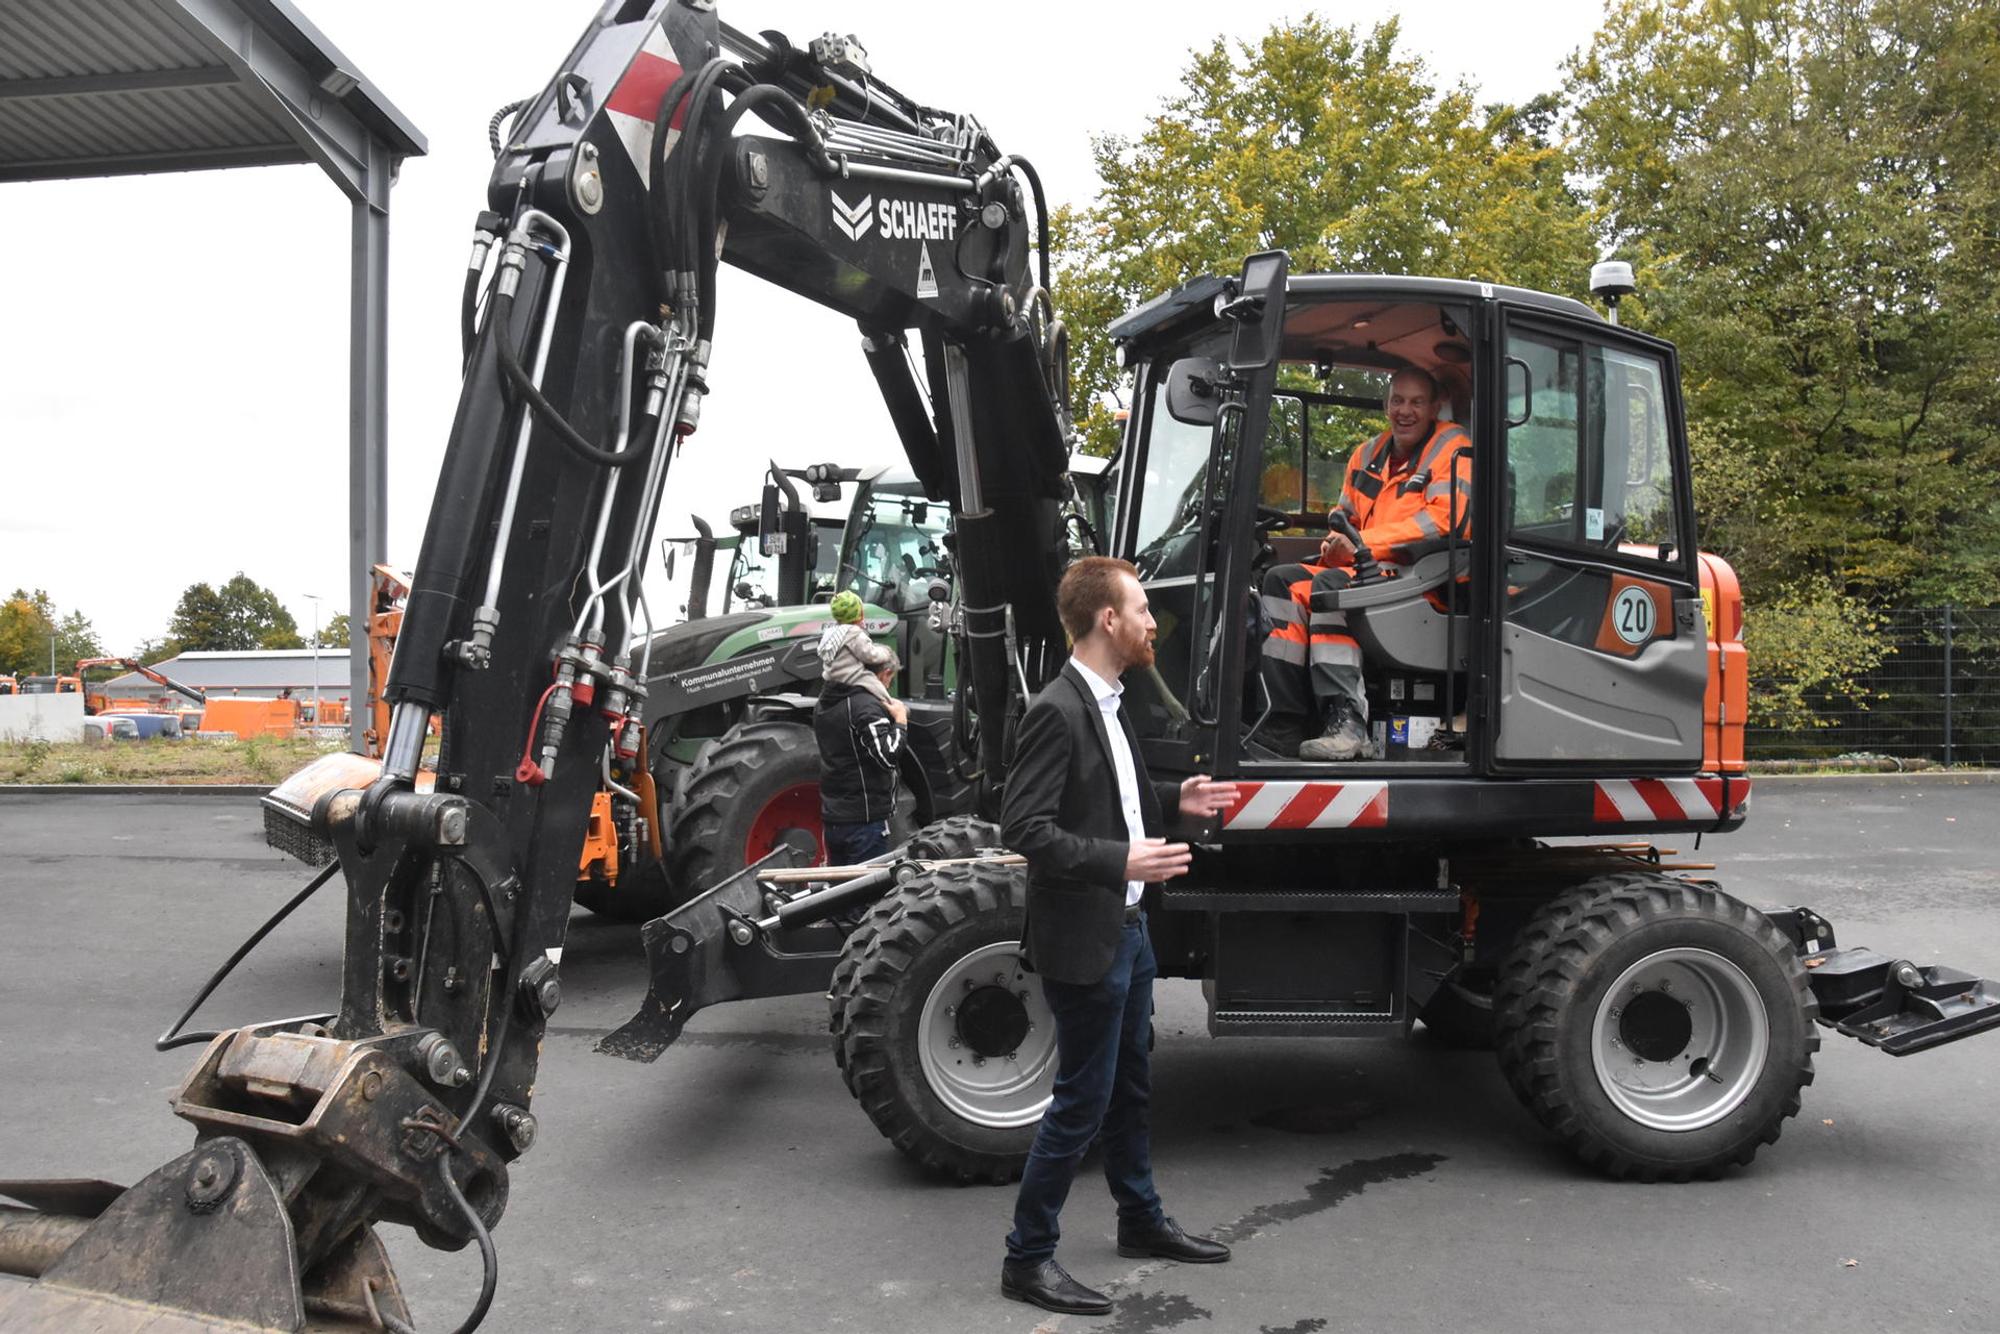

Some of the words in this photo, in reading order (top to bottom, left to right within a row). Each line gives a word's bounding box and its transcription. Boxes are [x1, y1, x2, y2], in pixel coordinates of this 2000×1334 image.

[879, 198, 957, 240] SCHAEFF
[1622, 598, 1648, 632] 20
[681, 656, 775, 687] Kommunalunternehmen
